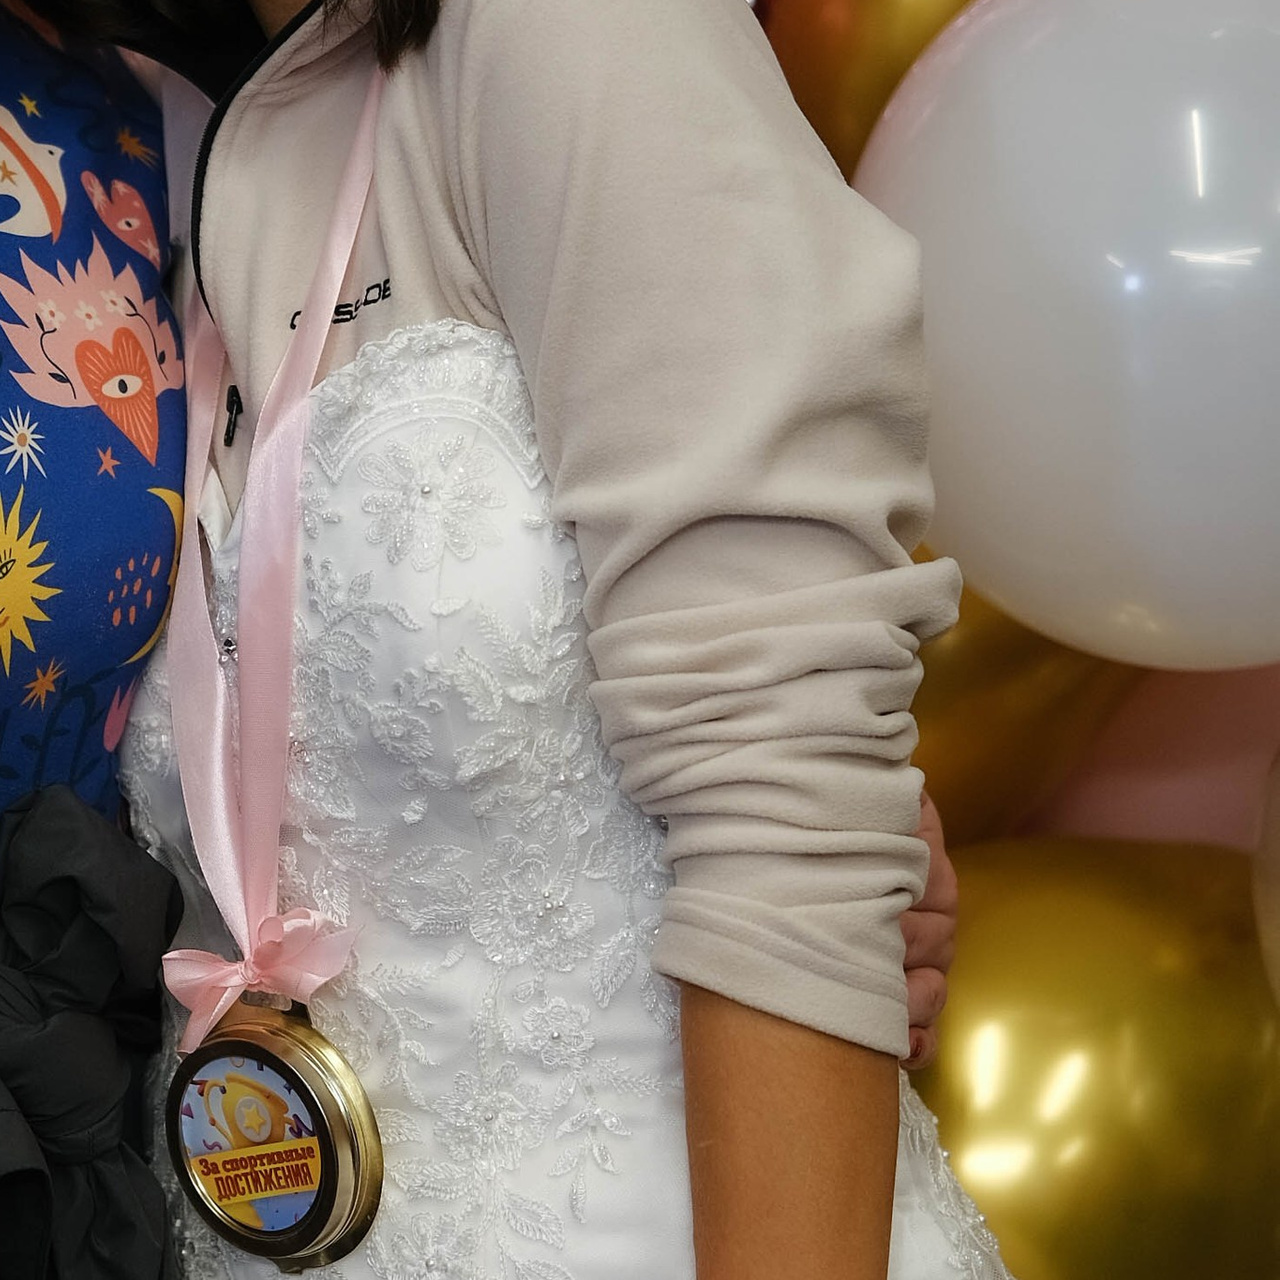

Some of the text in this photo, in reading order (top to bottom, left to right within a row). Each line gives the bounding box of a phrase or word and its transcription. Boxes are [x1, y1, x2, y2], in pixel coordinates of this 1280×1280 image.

[198, 1145, 316, 1177] За спортивные
[213, 1161, 315, 1203] ДОСТИЖЕНИЯ
